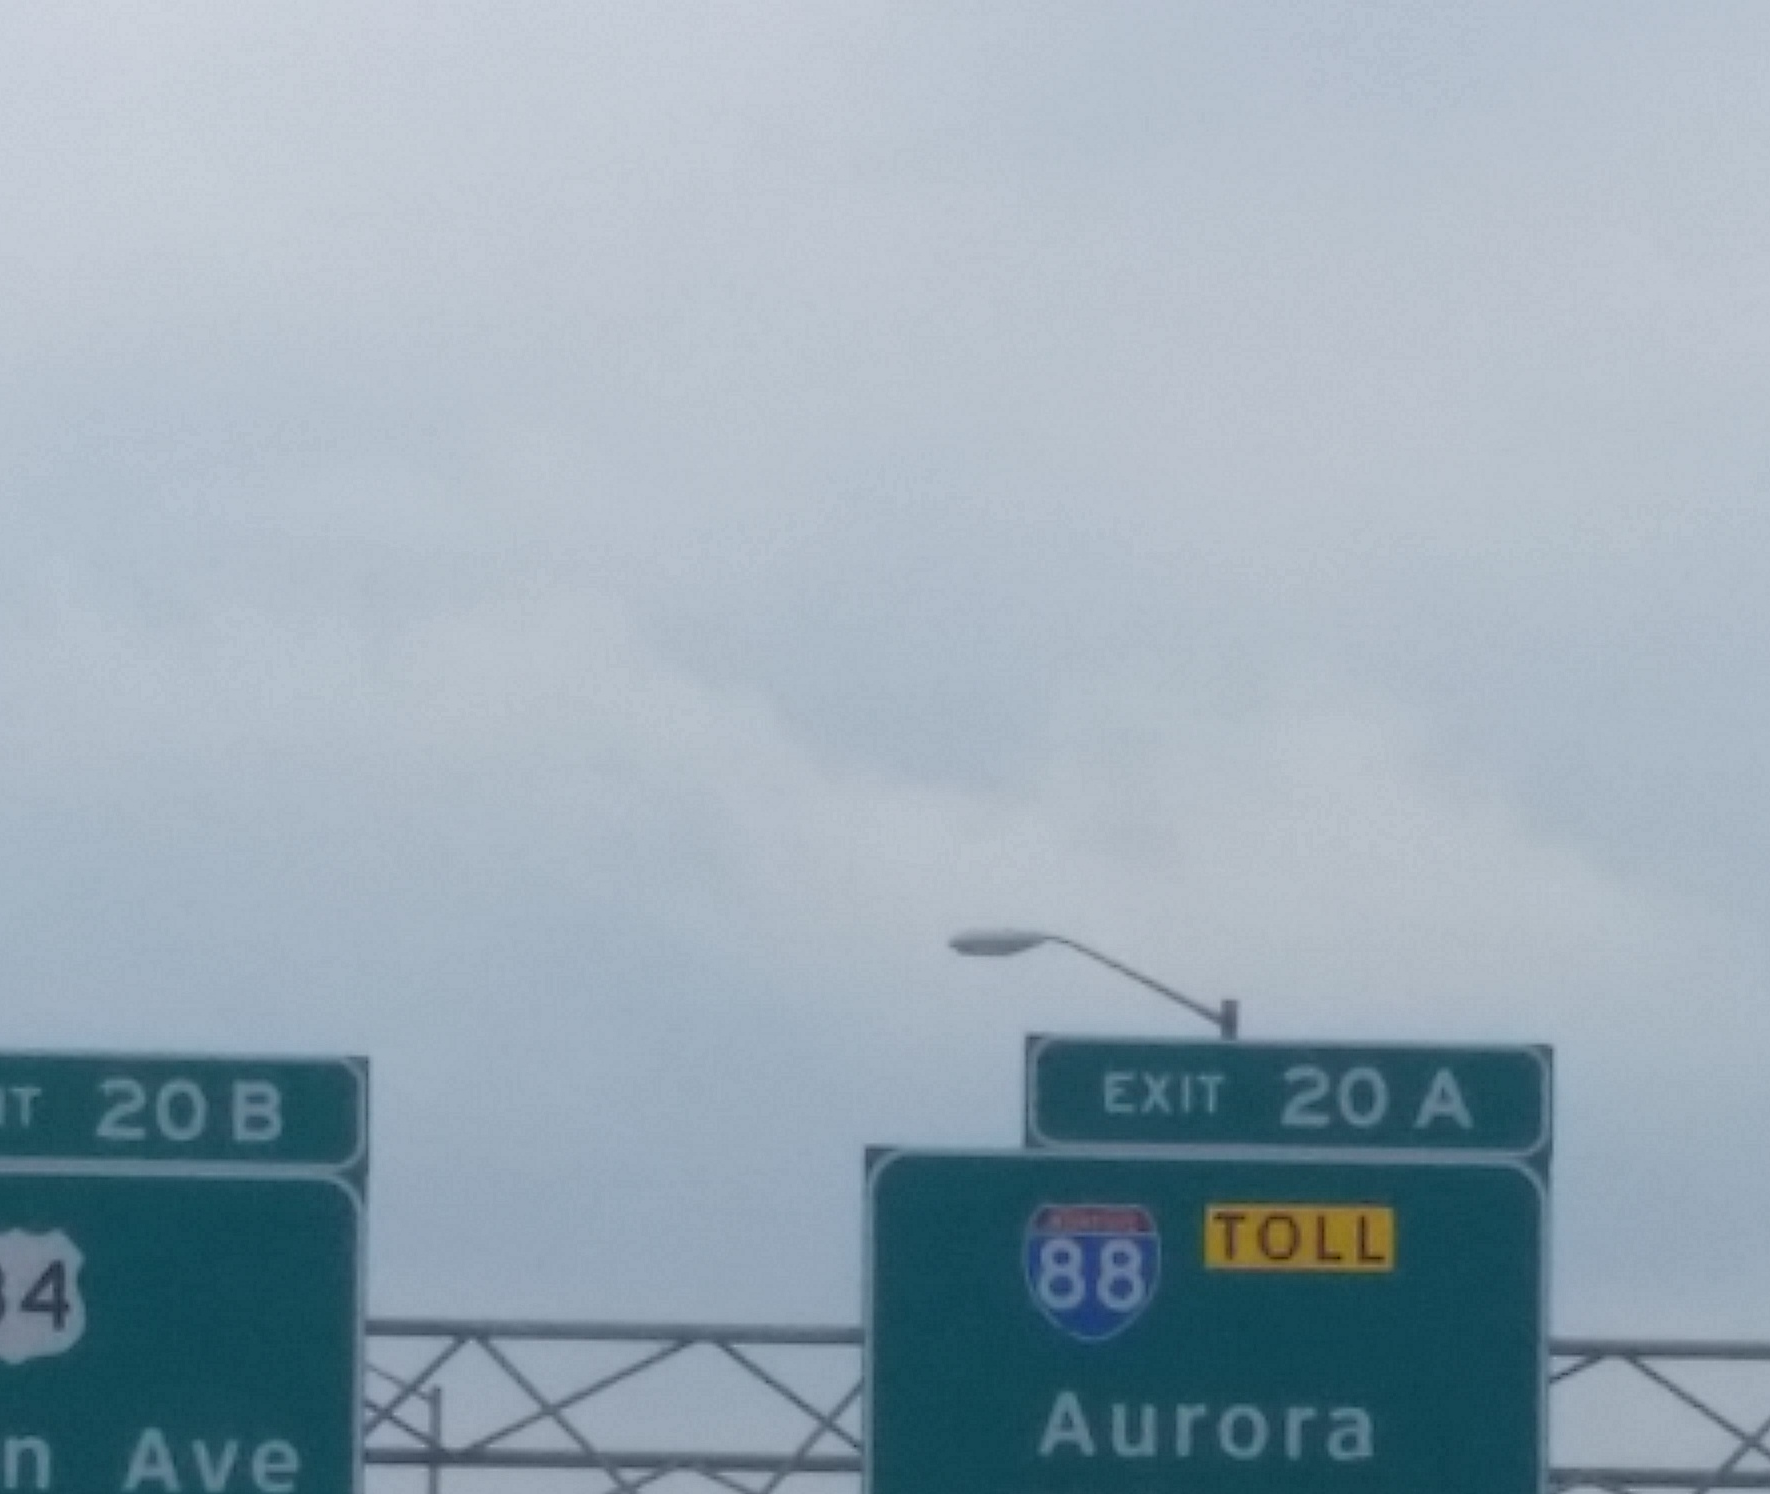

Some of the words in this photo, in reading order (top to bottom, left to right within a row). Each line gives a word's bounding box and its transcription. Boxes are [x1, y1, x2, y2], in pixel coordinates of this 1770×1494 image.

[1104, 1071, 1226, 1115] EXIT
[1211, 1211, 1388, 1264] TOLL
[1037, 1236, 1145, 1313] 88
[1037, 1390, 1377, 1463] Aurora
